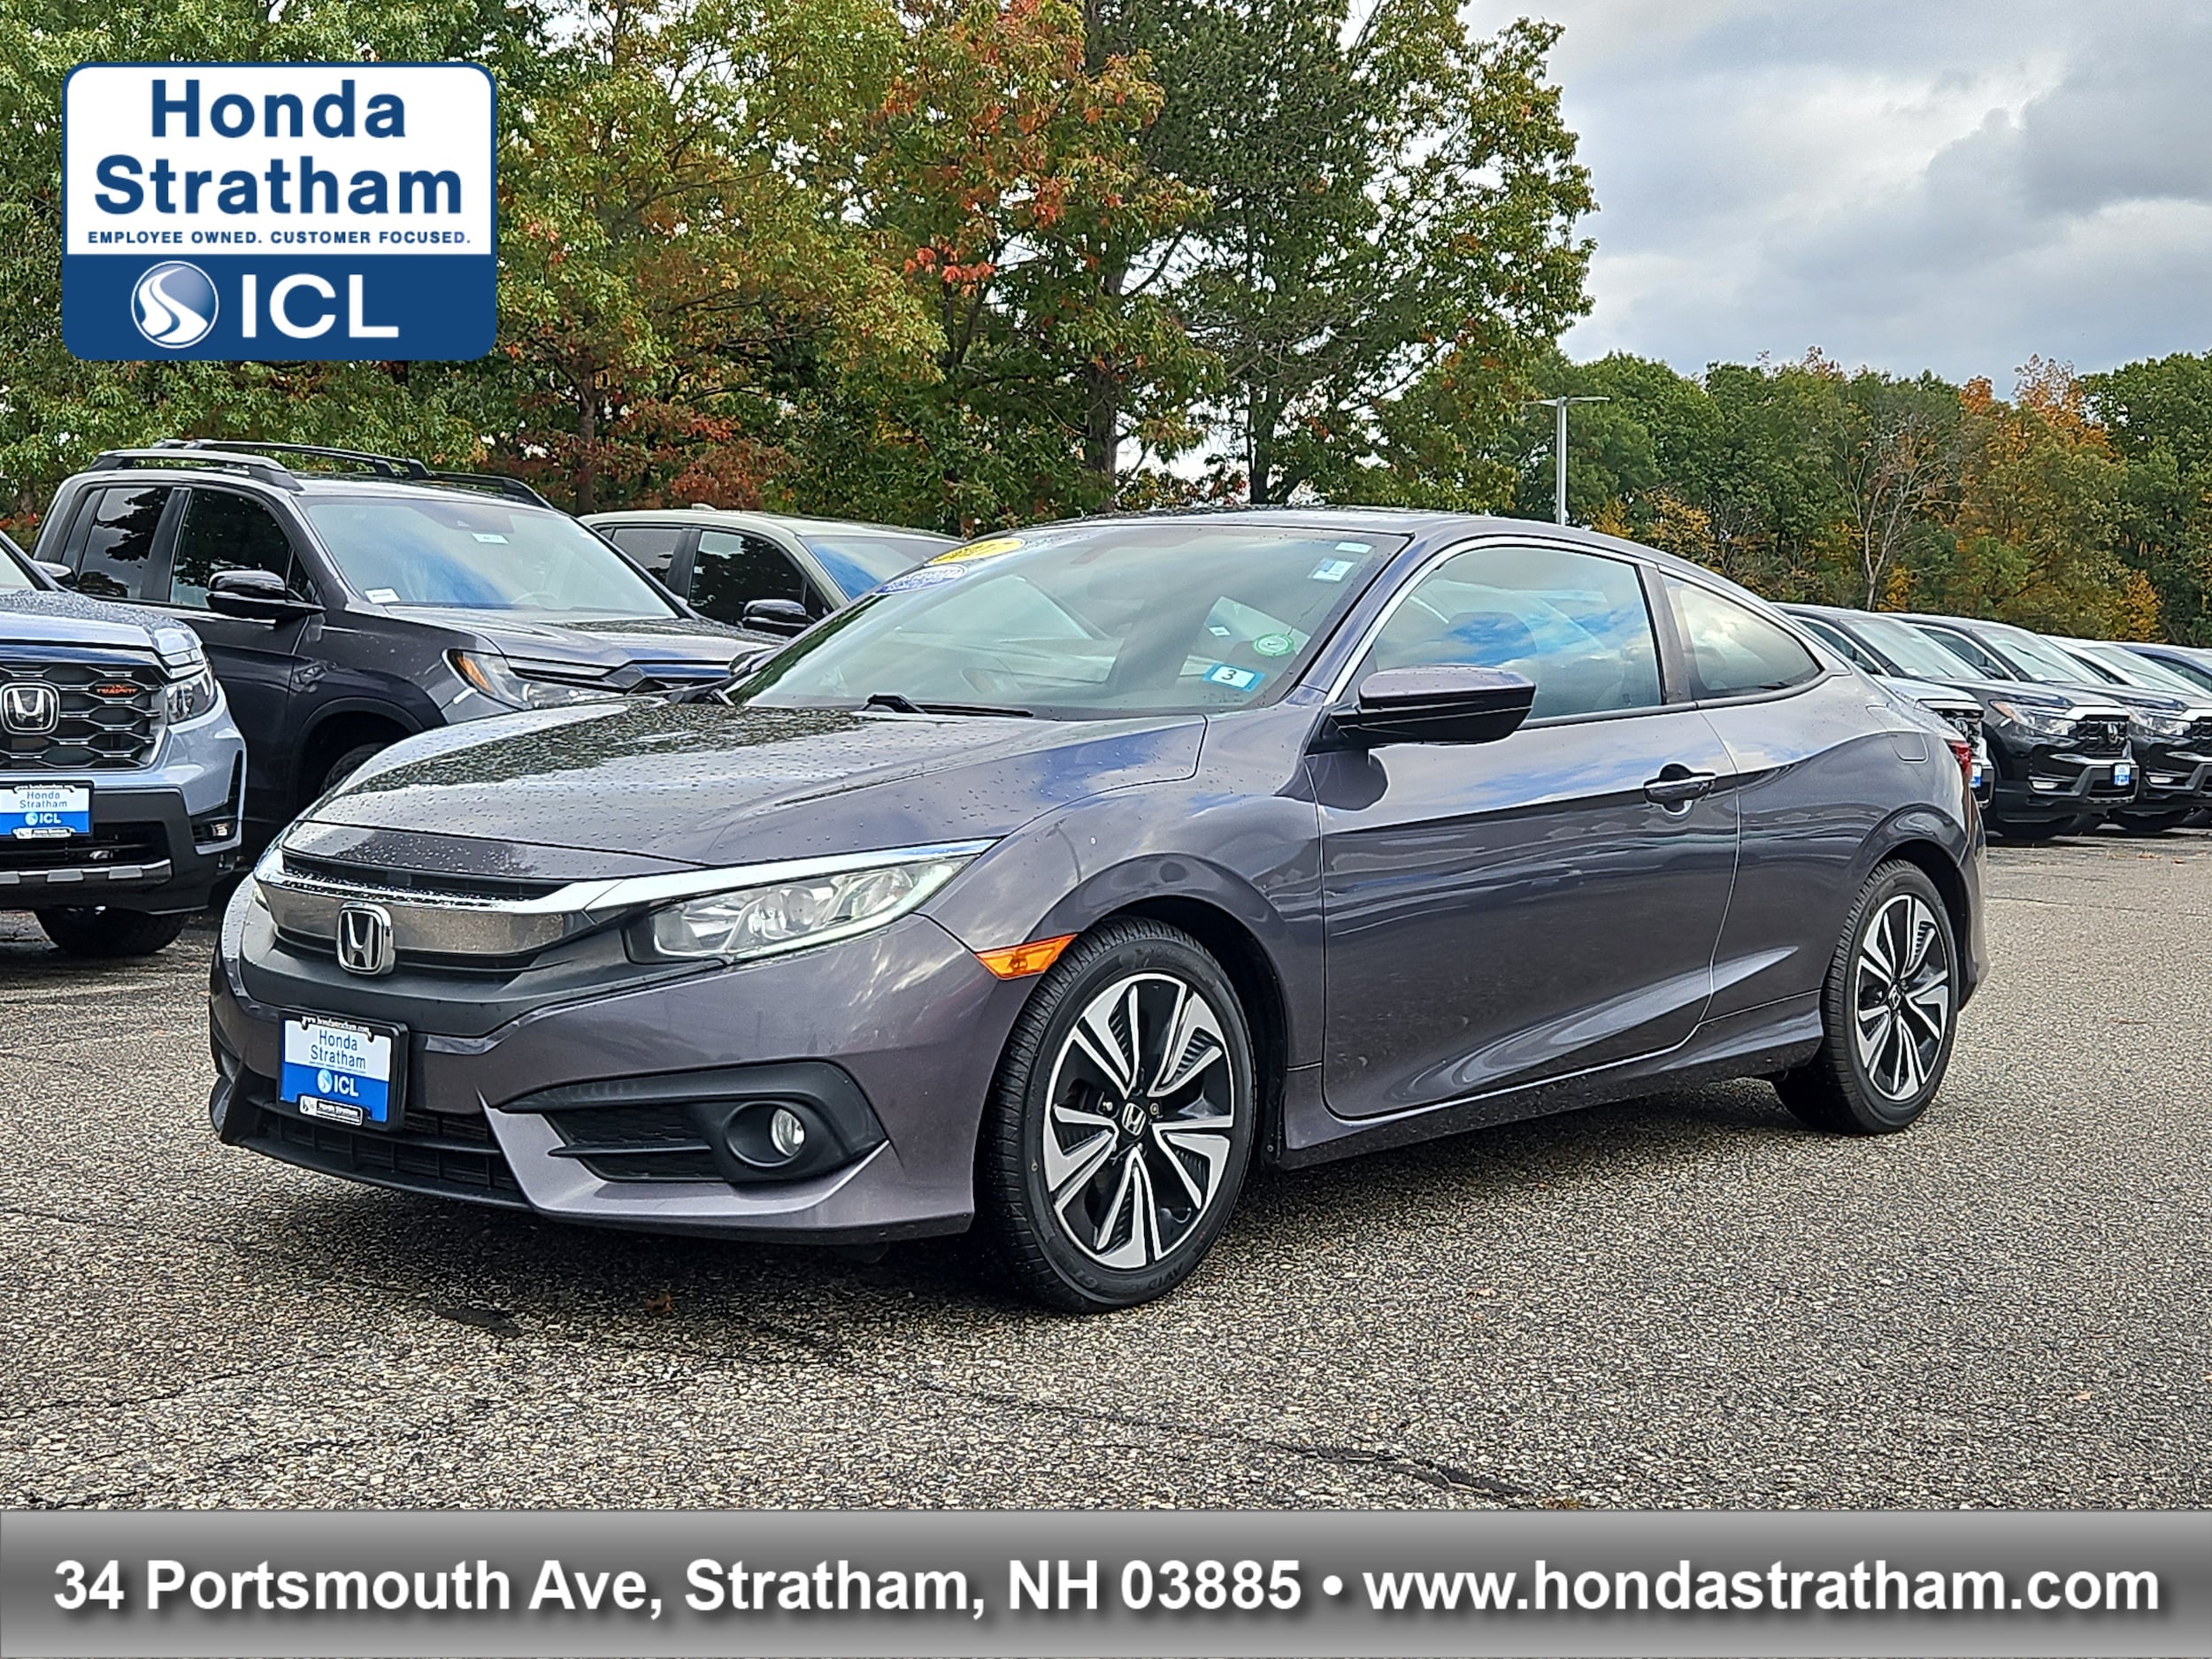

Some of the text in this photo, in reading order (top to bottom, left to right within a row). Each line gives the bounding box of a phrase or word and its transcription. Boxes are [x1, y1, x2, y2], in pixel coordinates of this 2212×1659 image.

[1221, 669, 1237, 680] 3
[27, 791, 60, 800] Honda
[19, 800, 67, 809] Stratham
[39, 813, 62, 824] ICL
[319, 1029, 357, 1051] Honda
[311, 1044, 366, 1070] Stratham
[334, 1074, 359, 1097] ICL
